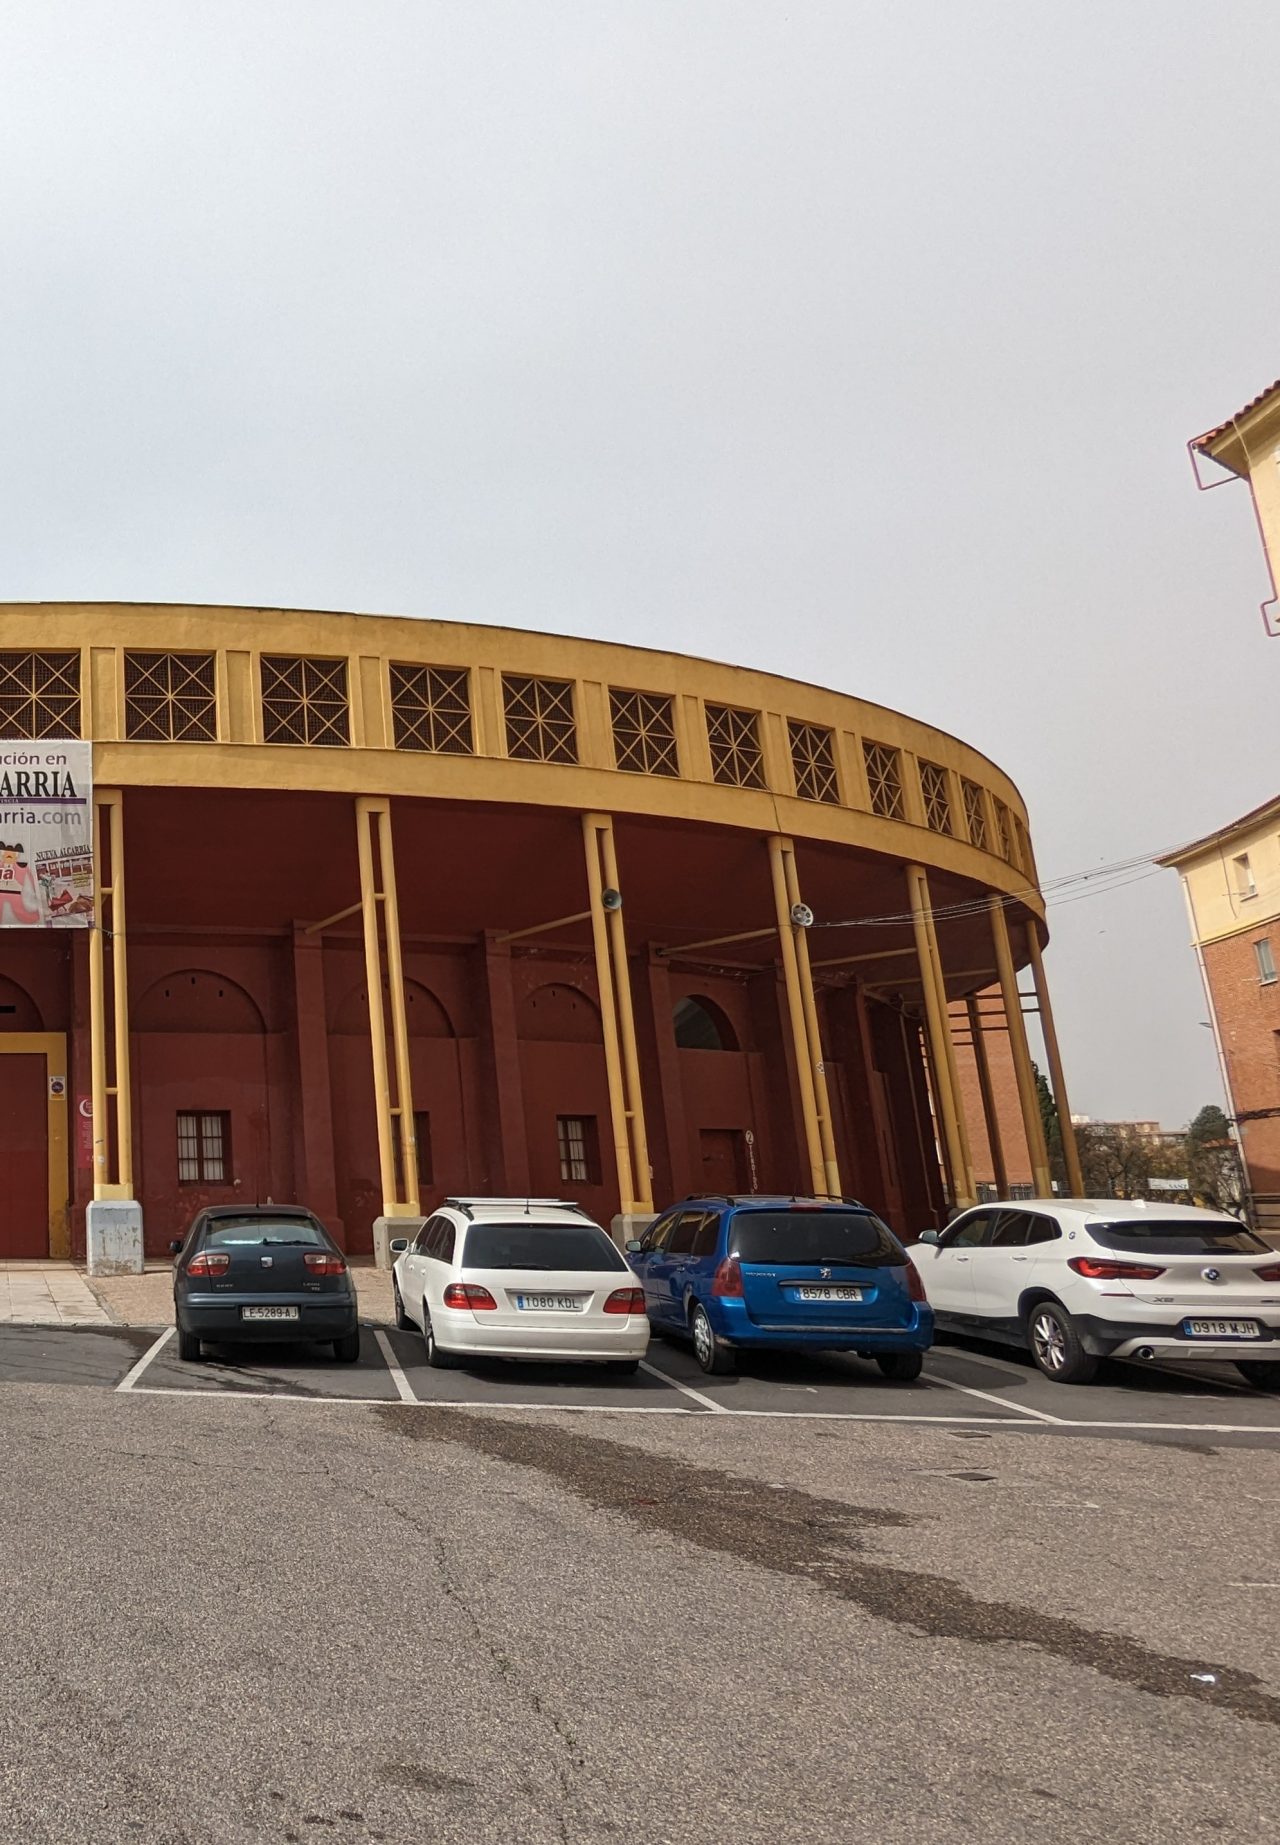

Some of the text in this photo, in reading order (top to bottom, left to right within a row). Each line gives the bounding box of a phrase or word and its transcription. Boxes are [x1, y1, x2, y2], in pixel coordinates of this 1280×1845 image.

[45, 754, 67, 766] en
[36, 844, 91, 861] NUEVA ALCARRIA
[802, 1288, 858, 1300] 8578 CBR
[526, 1297, 579, 1308] 1080 KDL
[1192, 1322, 1227, 1333] 0918
